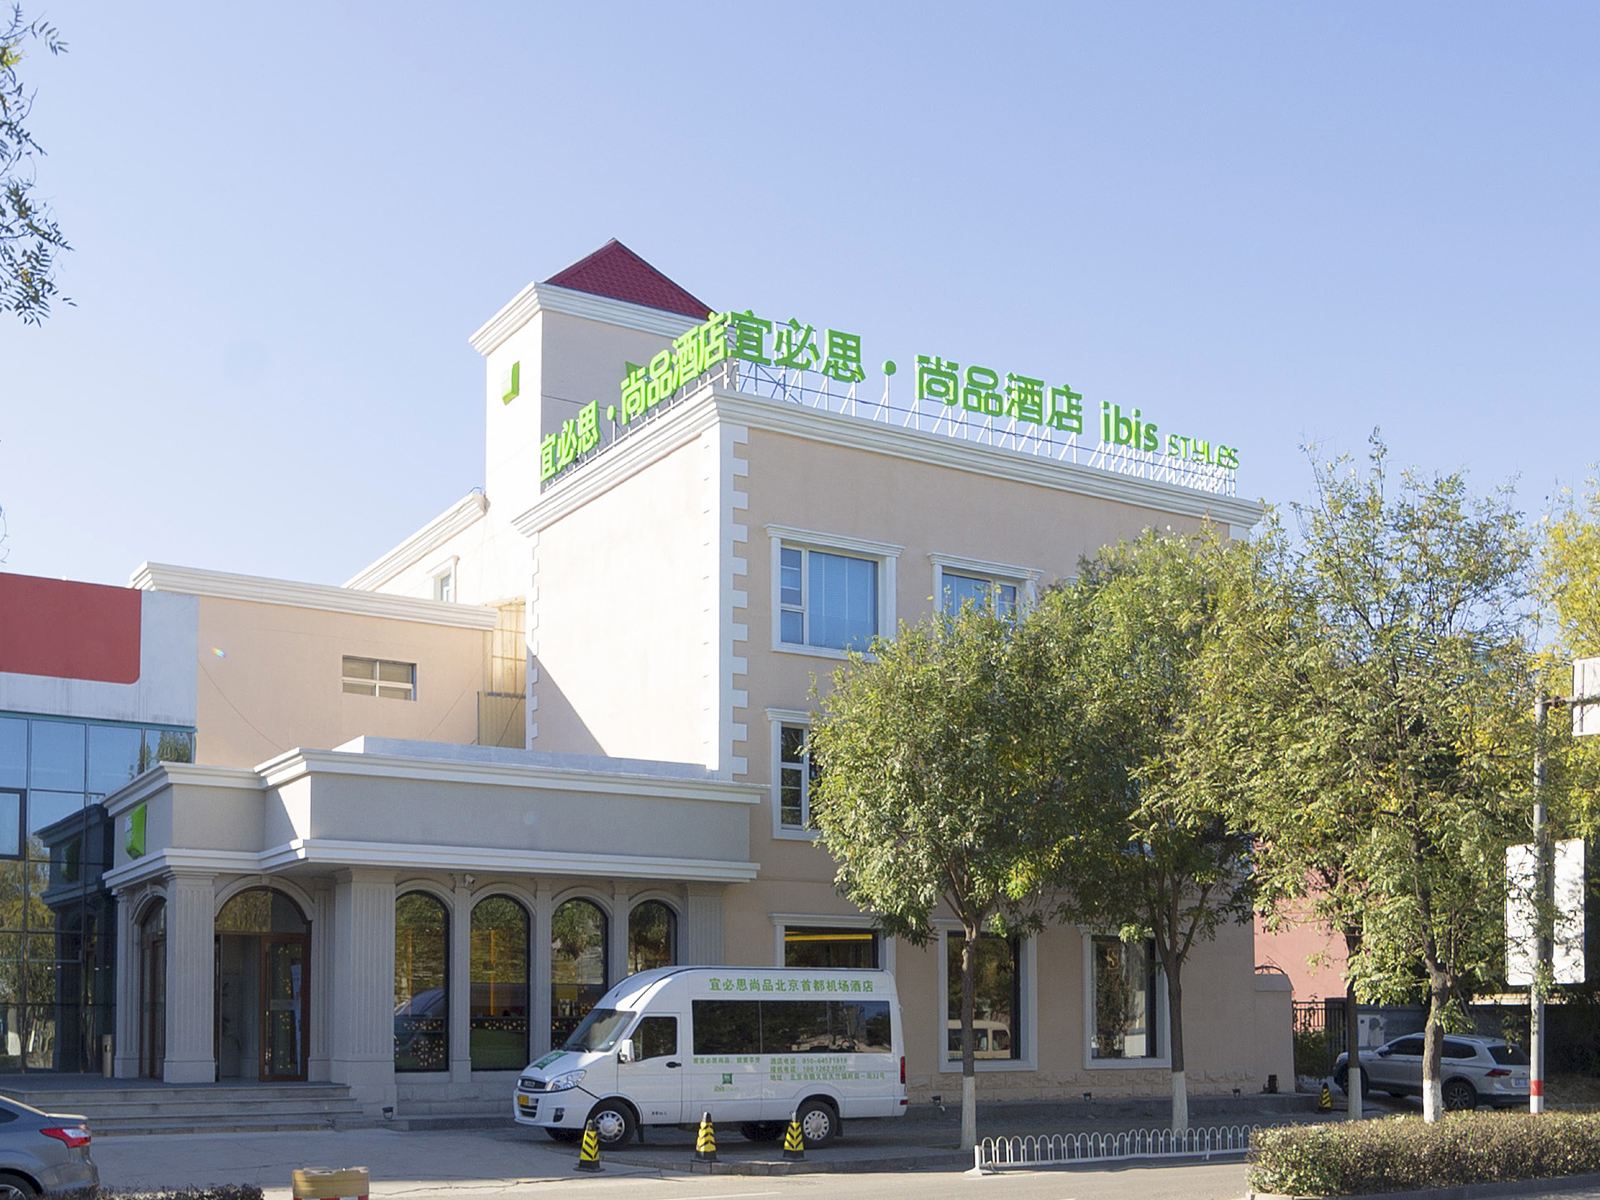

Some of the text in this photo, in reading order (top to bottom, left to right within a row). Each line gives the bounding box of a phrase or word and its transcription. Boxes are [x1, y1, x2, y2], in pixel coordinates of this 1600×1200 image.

[1101, 401, 1158, 452] ibis
[1167, 434, 1238, 470] STYLES
[709, 978, 874, 992] 宜必思尚品北京首都机场酒店
